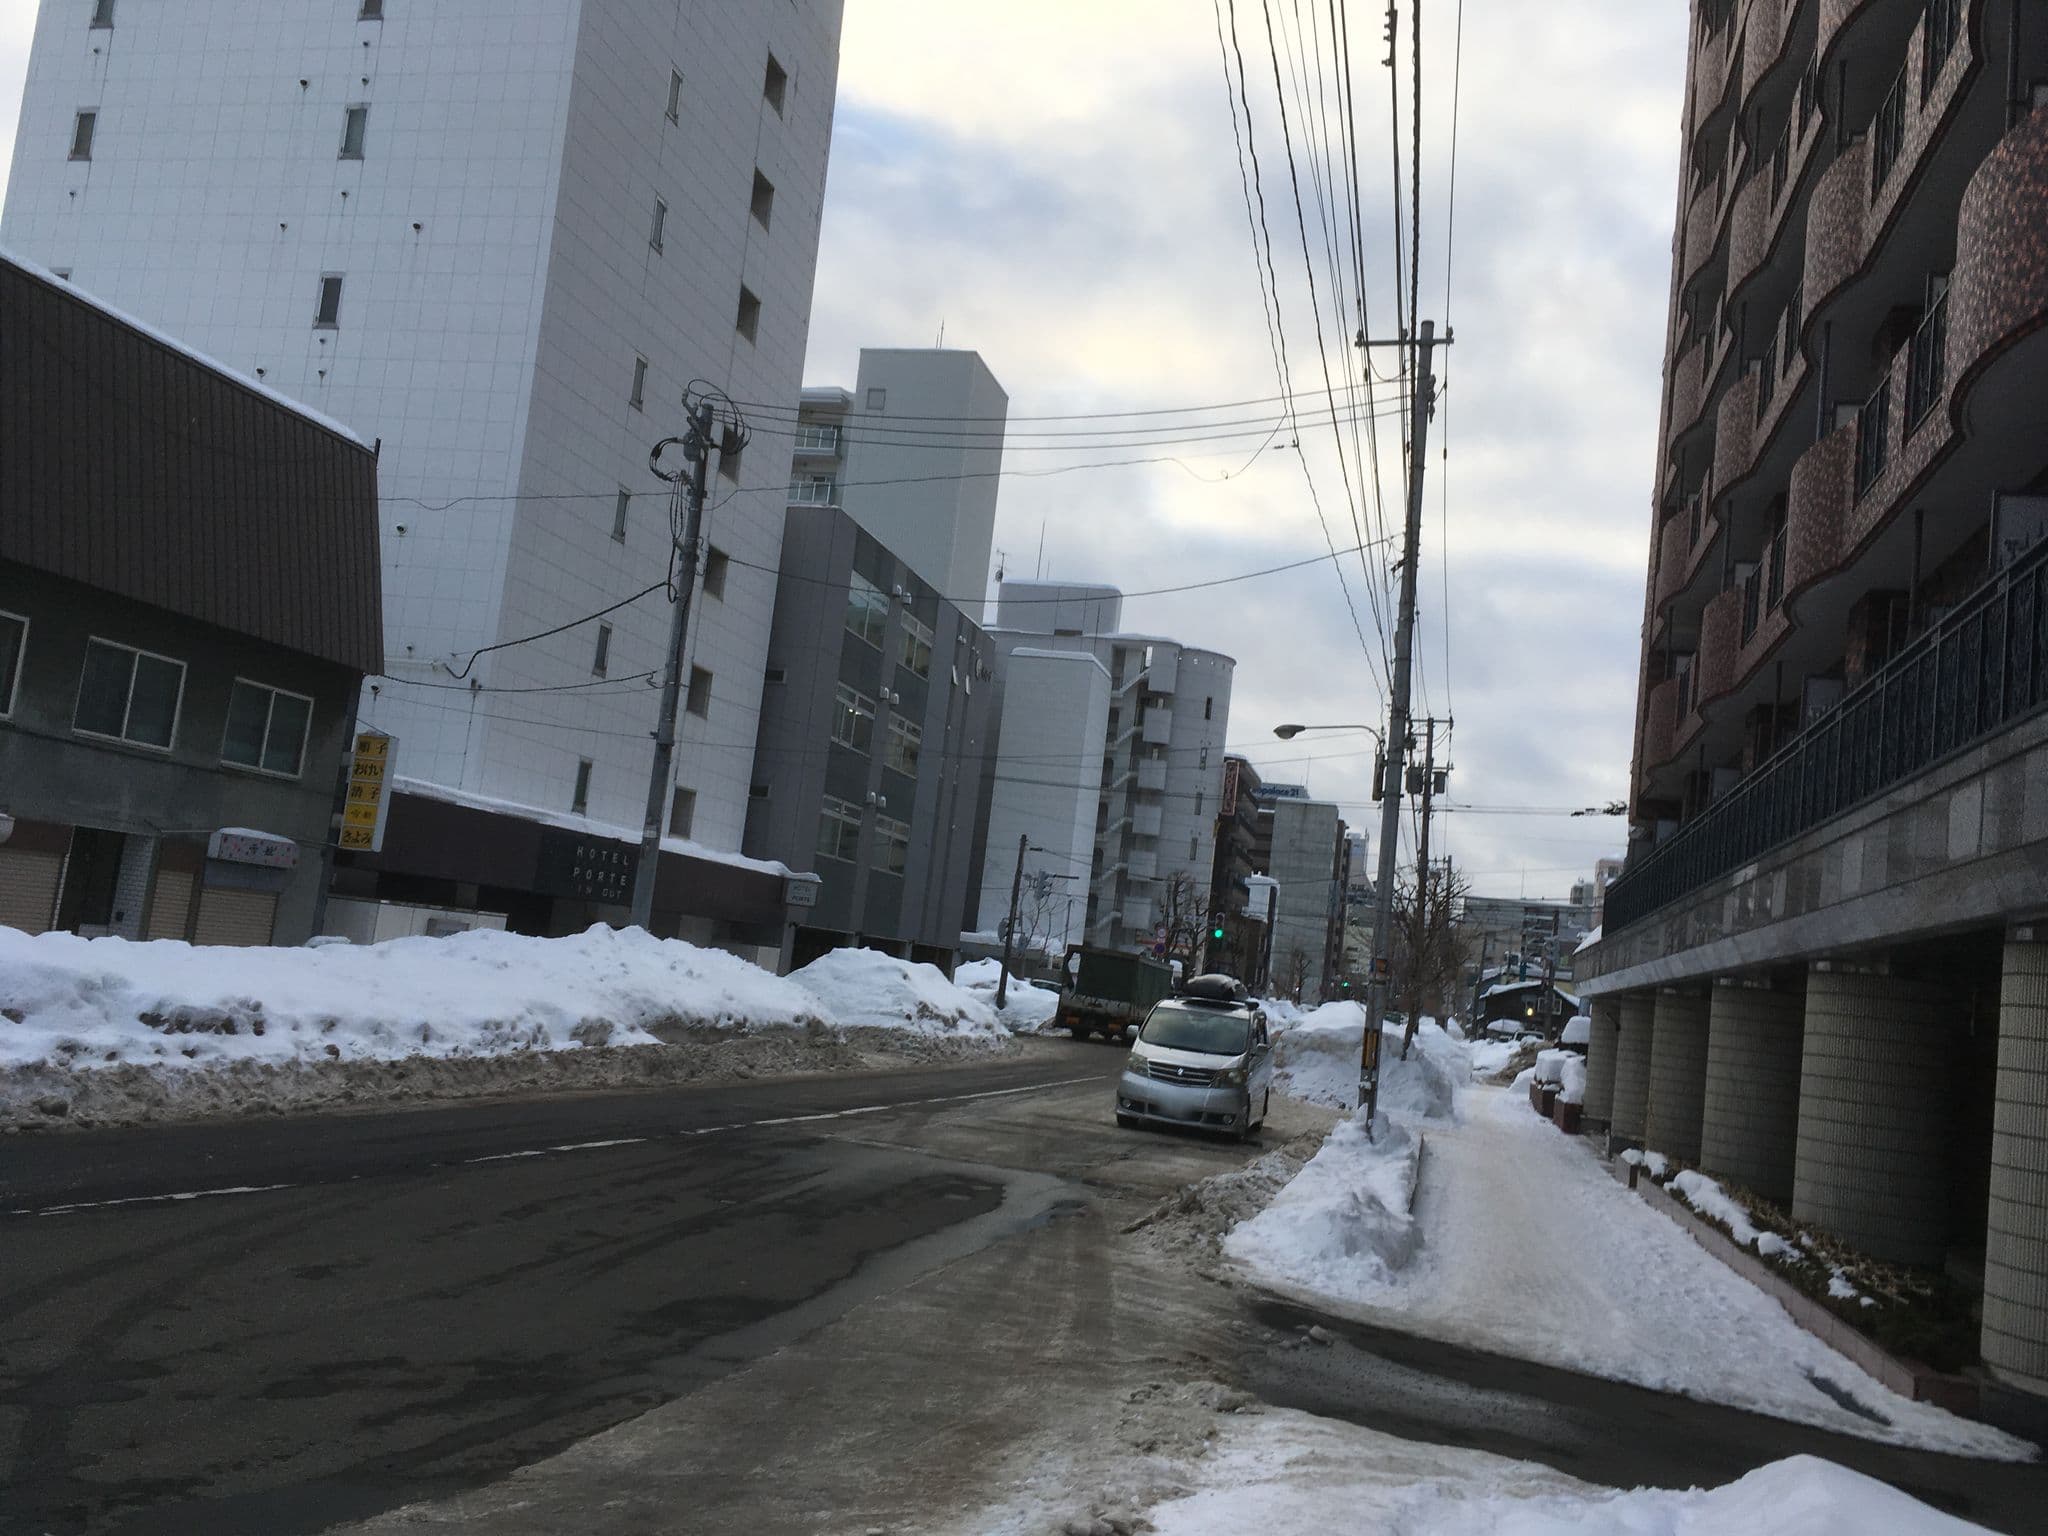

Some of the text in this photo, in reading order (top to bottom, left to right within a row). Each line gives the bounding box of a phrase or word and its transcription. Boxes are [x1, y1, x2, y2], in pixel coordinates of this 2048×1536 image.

[1256, 785, 1299, 797] opalace 21
[576, 845, 629, 866] HOTEL
[573, 866, 627, 886] PORTE
